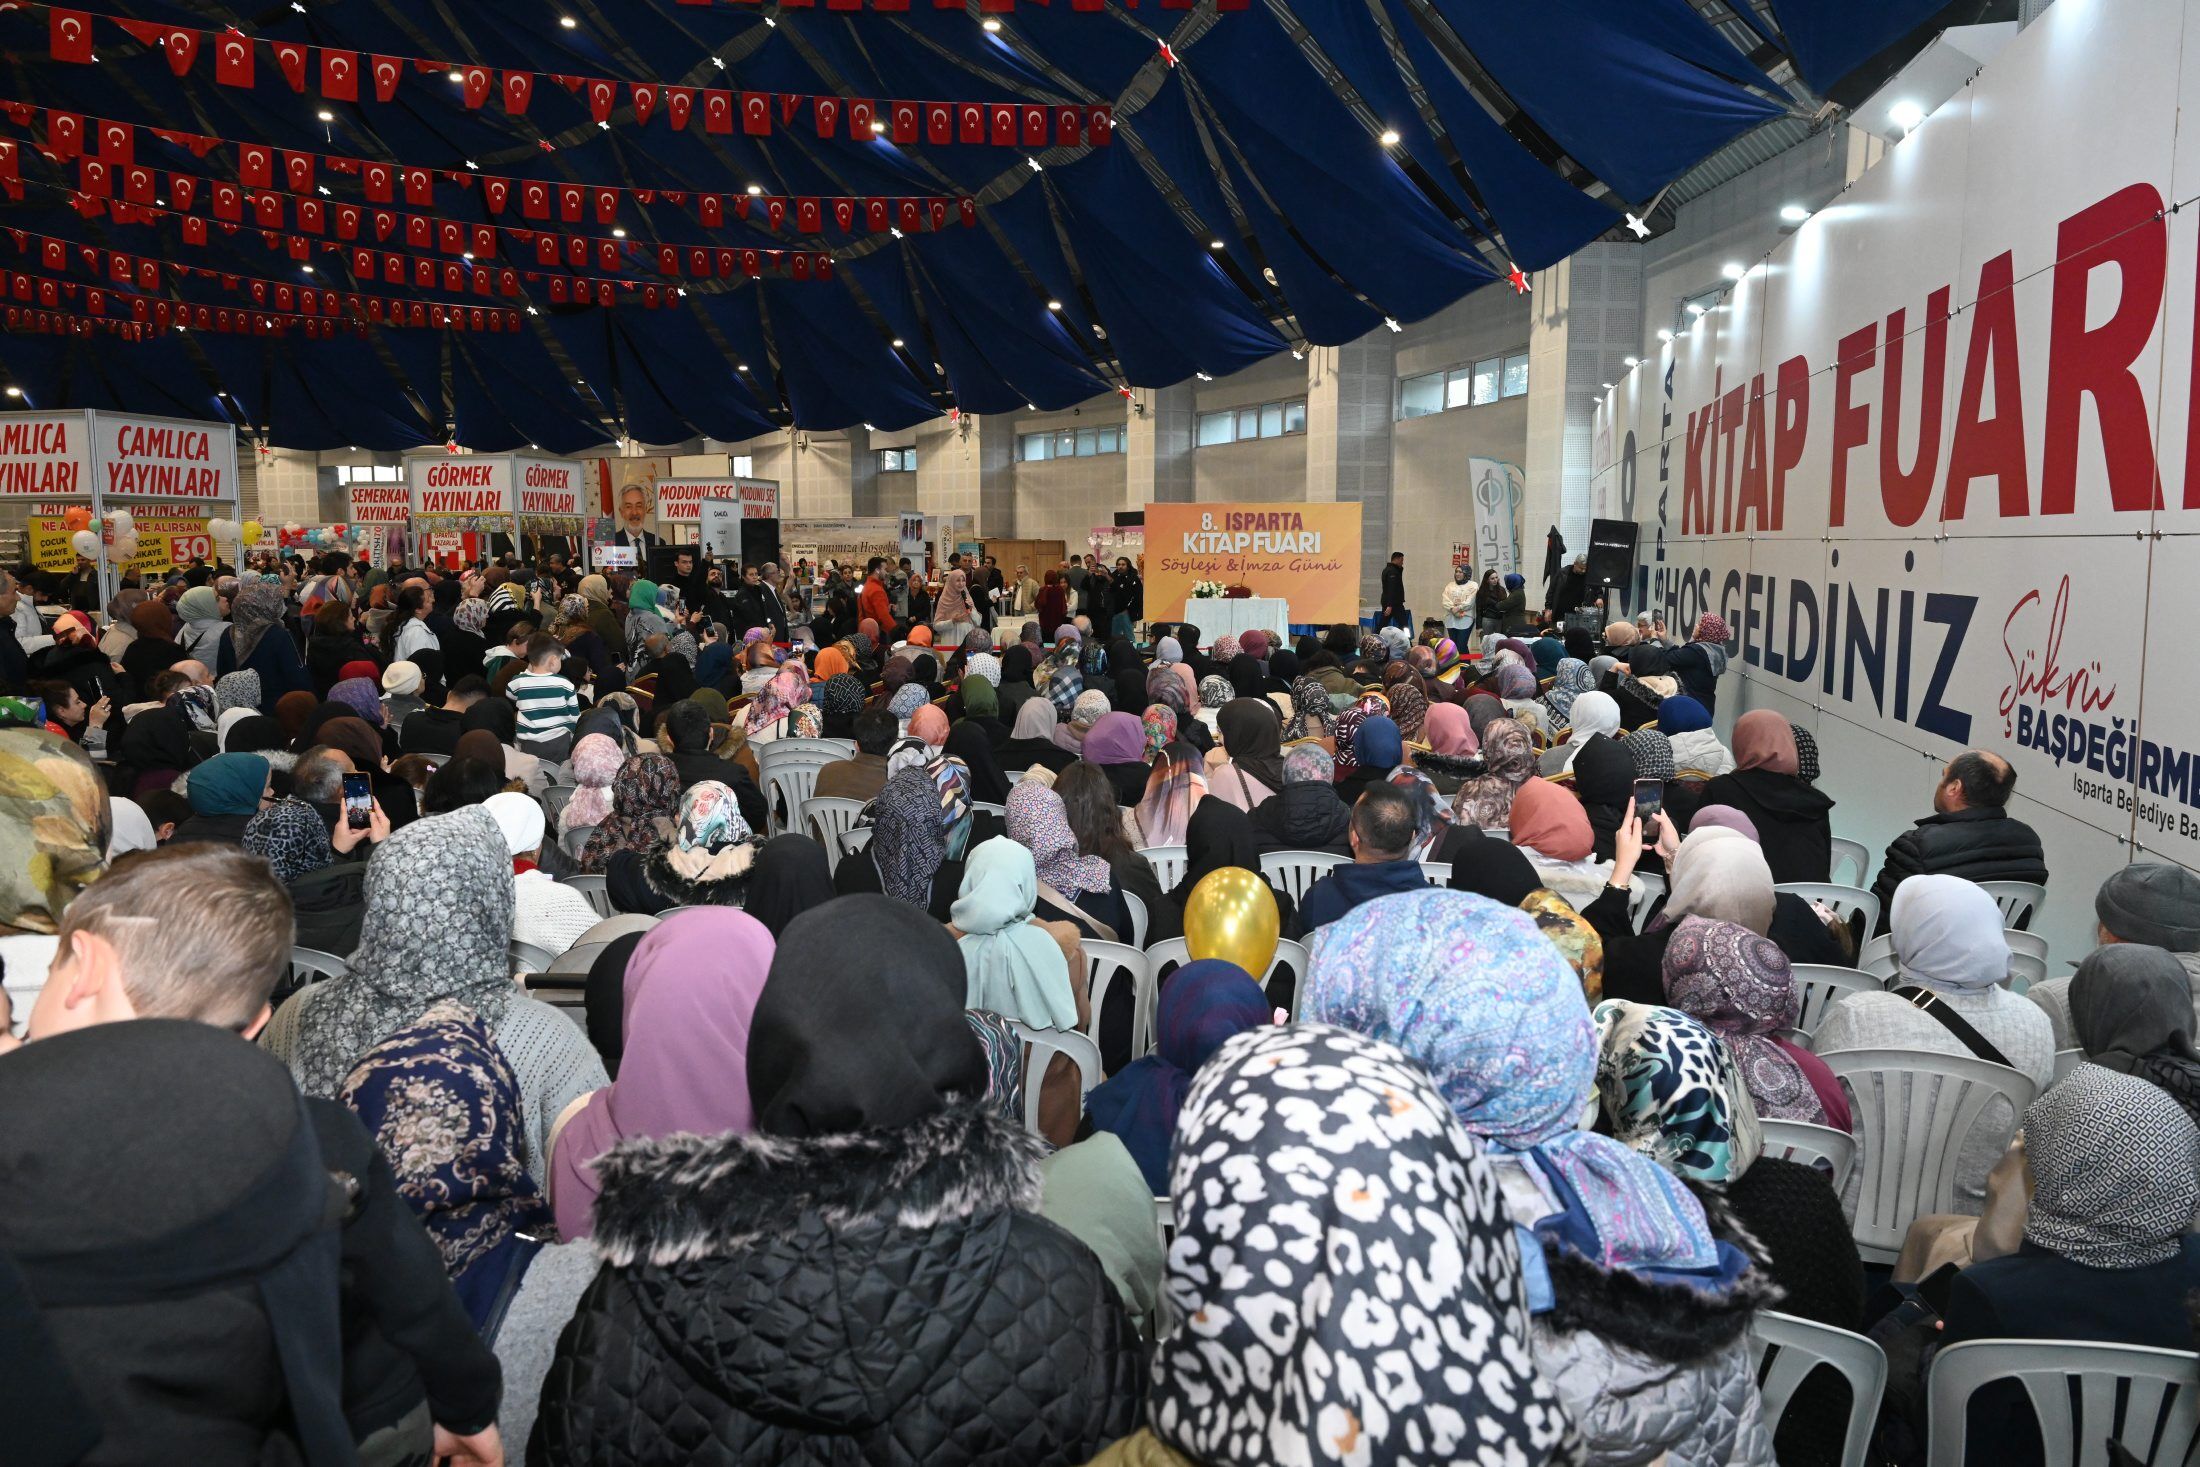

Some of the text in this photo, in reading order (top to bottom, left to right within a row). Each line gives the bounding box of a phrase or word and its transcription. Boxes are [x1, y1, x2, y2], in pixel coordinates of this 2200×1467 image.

[0, 423, 67, 455] MLICA
[117, 425, 210, 461] ÇAMLICA
[1682, 354, 1809, 536] KİTAP
[108, 462, 221, 497] YAYINLARI
[427, 462, 493, 487] GÖRMEK
[525, 463, 570, 489] GÖRMEK
[740, 485, 776, 504] MODUNU SEÇ
[1654, 356, 1676, 614] SPARTA
[351, 488, 410, 503] SEMERKAN
[422, 490, 501, 512] YAYINLARI
[522, 491, 575, 513] YAYINLARI
[356, 506, 409, 521] YAYINLAR
[667, 503, 701, 518] YAYIN
[743, 503, 773, 519] YAYINLARI
[134, 522, 202, 533] NE ALIRSAN
[1201, 512, 1304, 531] 8. ISPARTA
[40, 537, 67, 548] ÇOCUK
[40, 547, 68, 558] HİKAYE
[136, 537, 162, 548] OCUK
[174, 536, 210, 561] 30
[860, 541, 900, 557] Hoşgeldi
[1183, 531, 1321, 554] KİTAP FUARI
[35, 557, 75, 569] KİTAPLARI
[1161, 557, 1222, 574] Söyleşi
[1289, 558, 1343, 572] Günü
[1721, 549, 1979, 745] GELDİNİZ
[2073, 772, 2200, 841] Isparta Belediye Ba
